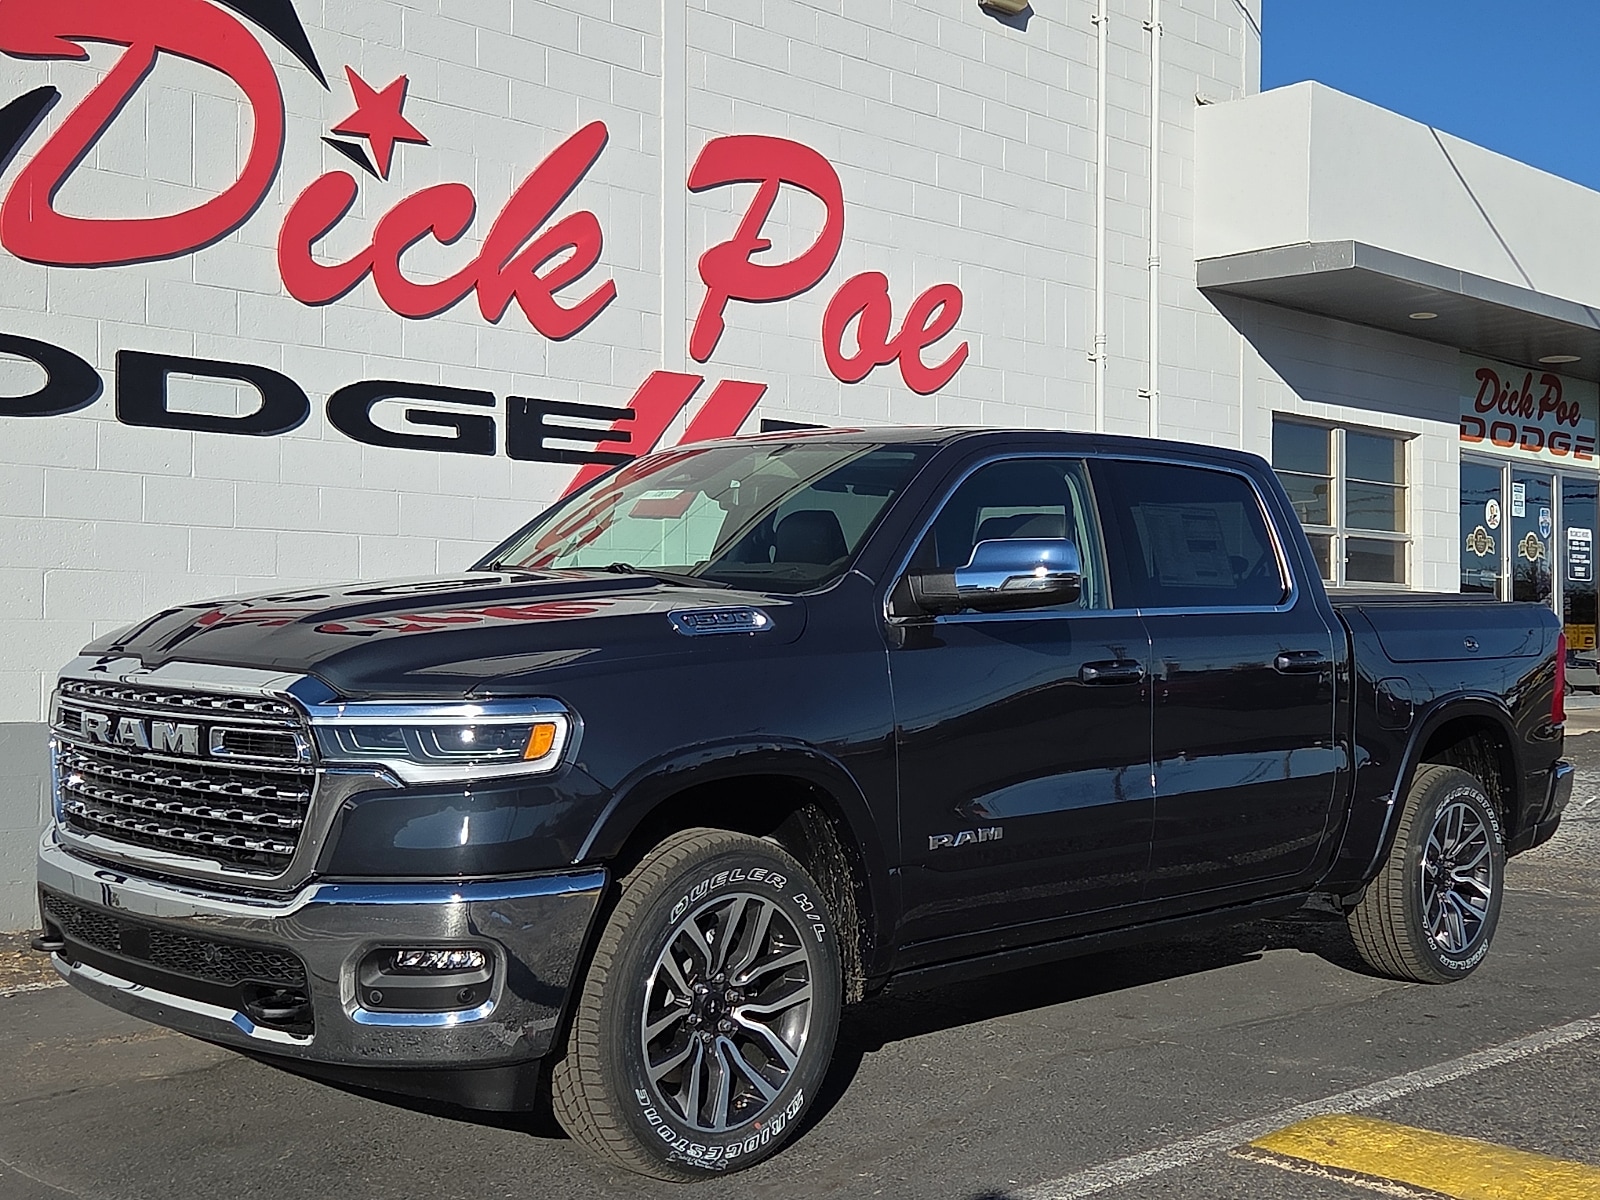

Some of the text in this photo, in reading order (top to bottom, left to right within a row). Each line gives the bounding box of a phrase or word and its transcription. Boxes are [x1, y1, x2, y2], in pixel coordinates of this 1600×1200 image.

[0, 0, 969, 395] Dick Poe
[0, 333, 637, 465] ODGE
[1475, 367, 1581, 428] Dick Poe
[1460, 415, 1596, 461] DODGE
[80, 711, 200, 756] RAM
[928, 826, 1004, 851] RAM
[669, 867, 788, 925] DUELER
[635, 1087, 804, 1160] BRIDGESTONE
